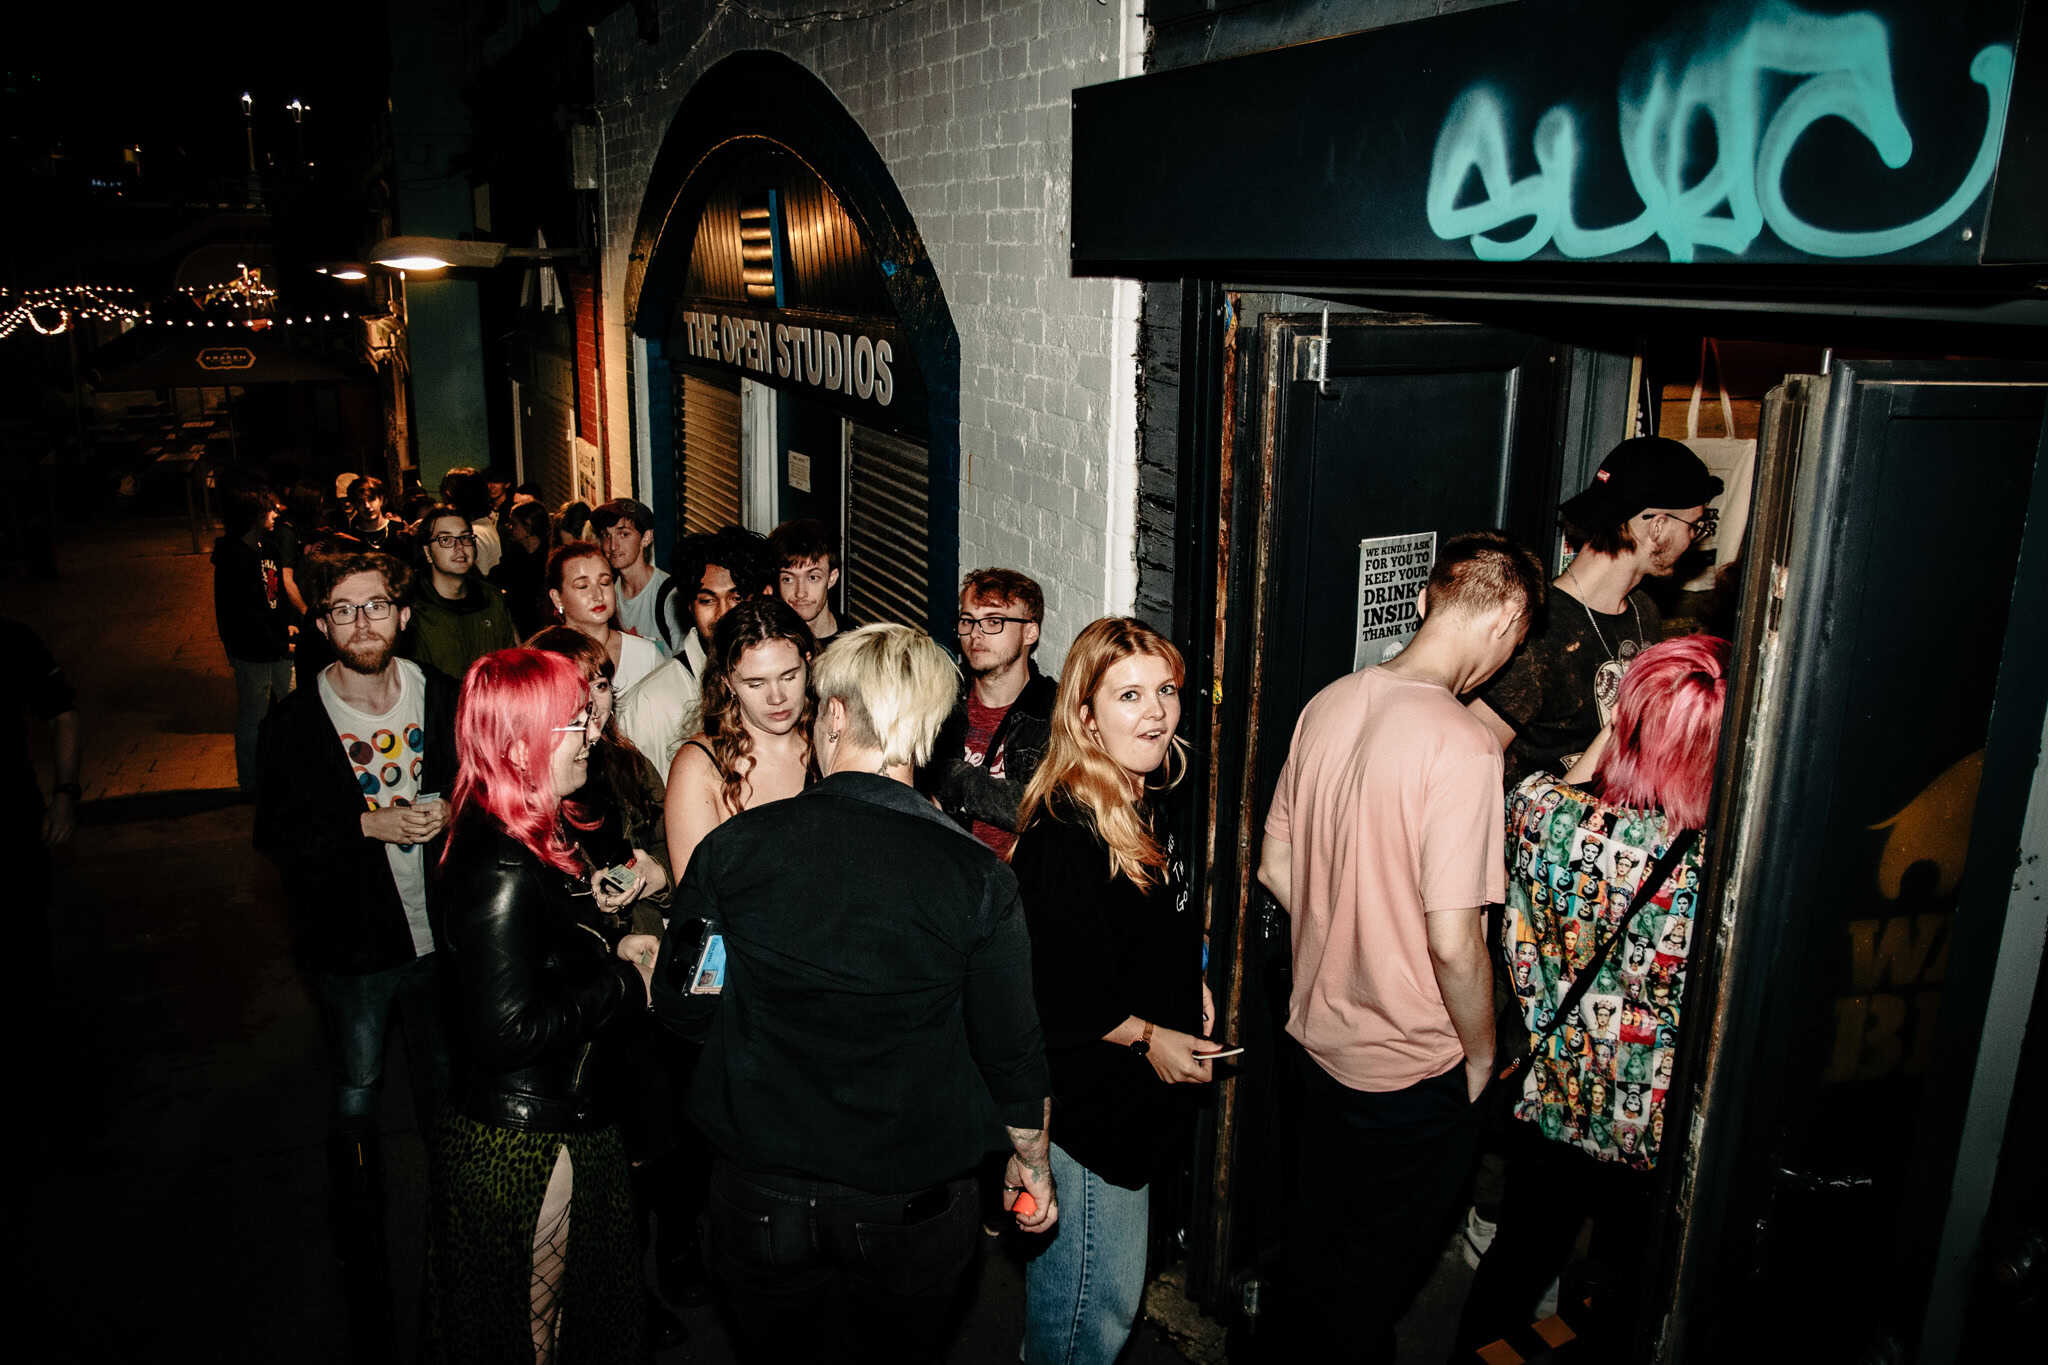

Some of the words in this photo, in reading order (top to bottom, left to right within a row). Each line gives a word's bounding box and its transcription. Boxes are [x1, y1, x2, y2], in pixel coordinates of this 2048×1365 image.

[684, 311, 720, 361] THE
[721, 315, 773, 375] OPEN
[775, 323, 894, 407] STUDIOS
[1366, 547, 1380, 558] WE
[1381, 543, 1412, 556] KINDLY
[1413, 540, 1431, 551] ASK
[1365, 557, 1388, 572] FOR
[1391, 554, 1414, 568] YOU
[1415, 550, 1430, 564] TO
[1365, 570, 1396, 586] KEEP
[1398, 565, 1429, 581] YOUR
[1363, 601, 1421, 628] INSID
[1362, 623, 1402, 642] THANK
[1405, 621, 1419, 633] YO
